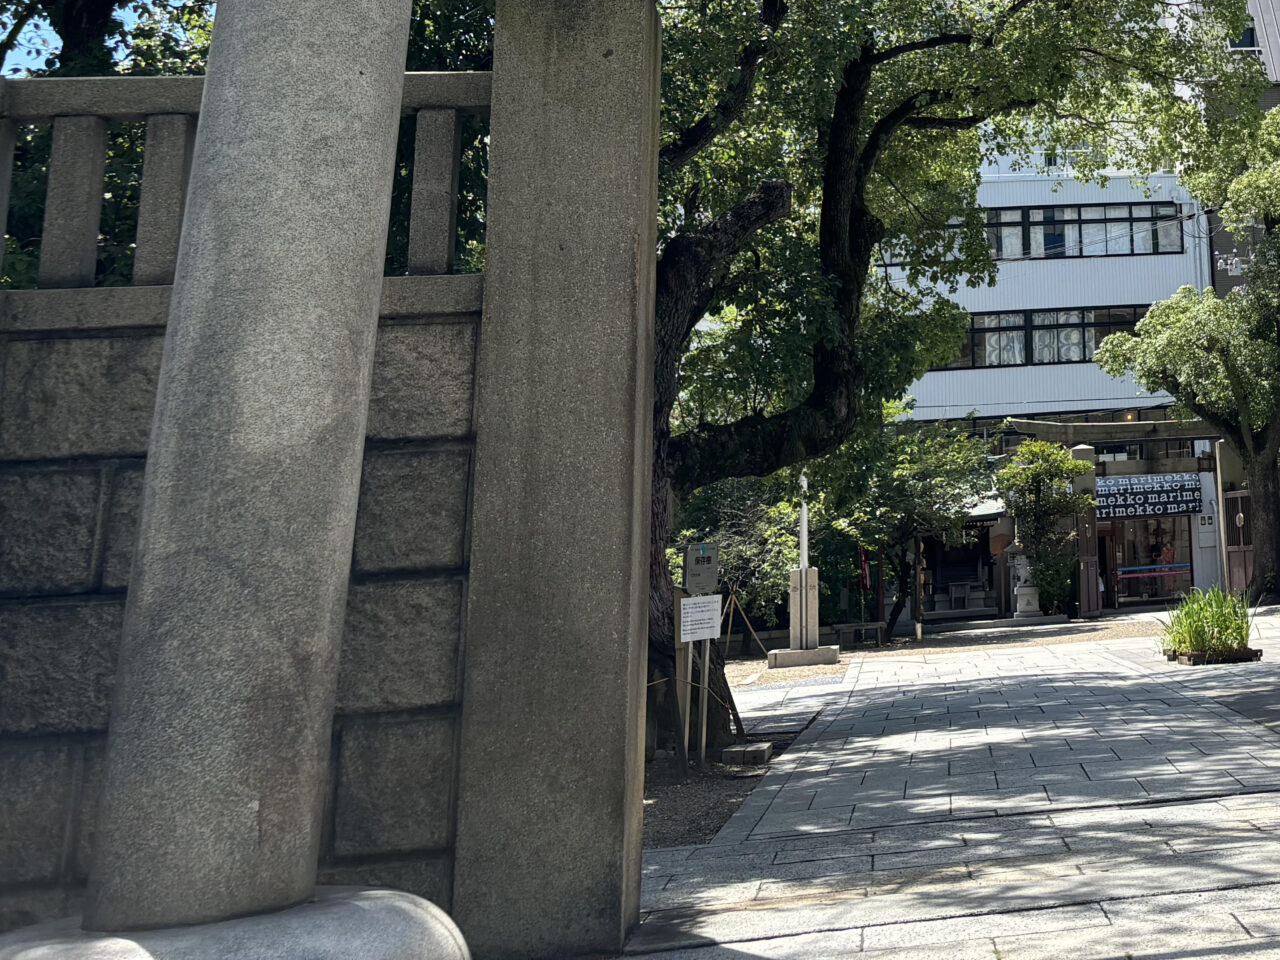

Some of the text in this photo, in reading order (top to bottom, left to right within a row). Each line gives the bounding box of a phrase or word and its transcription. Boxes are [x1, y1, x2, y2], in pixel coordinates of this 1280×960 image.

[1118, 473, 1199, 485] marimekko
[1098, 481, 1180, 494] marimekko
[1147, 489, 1200, 503] marime
